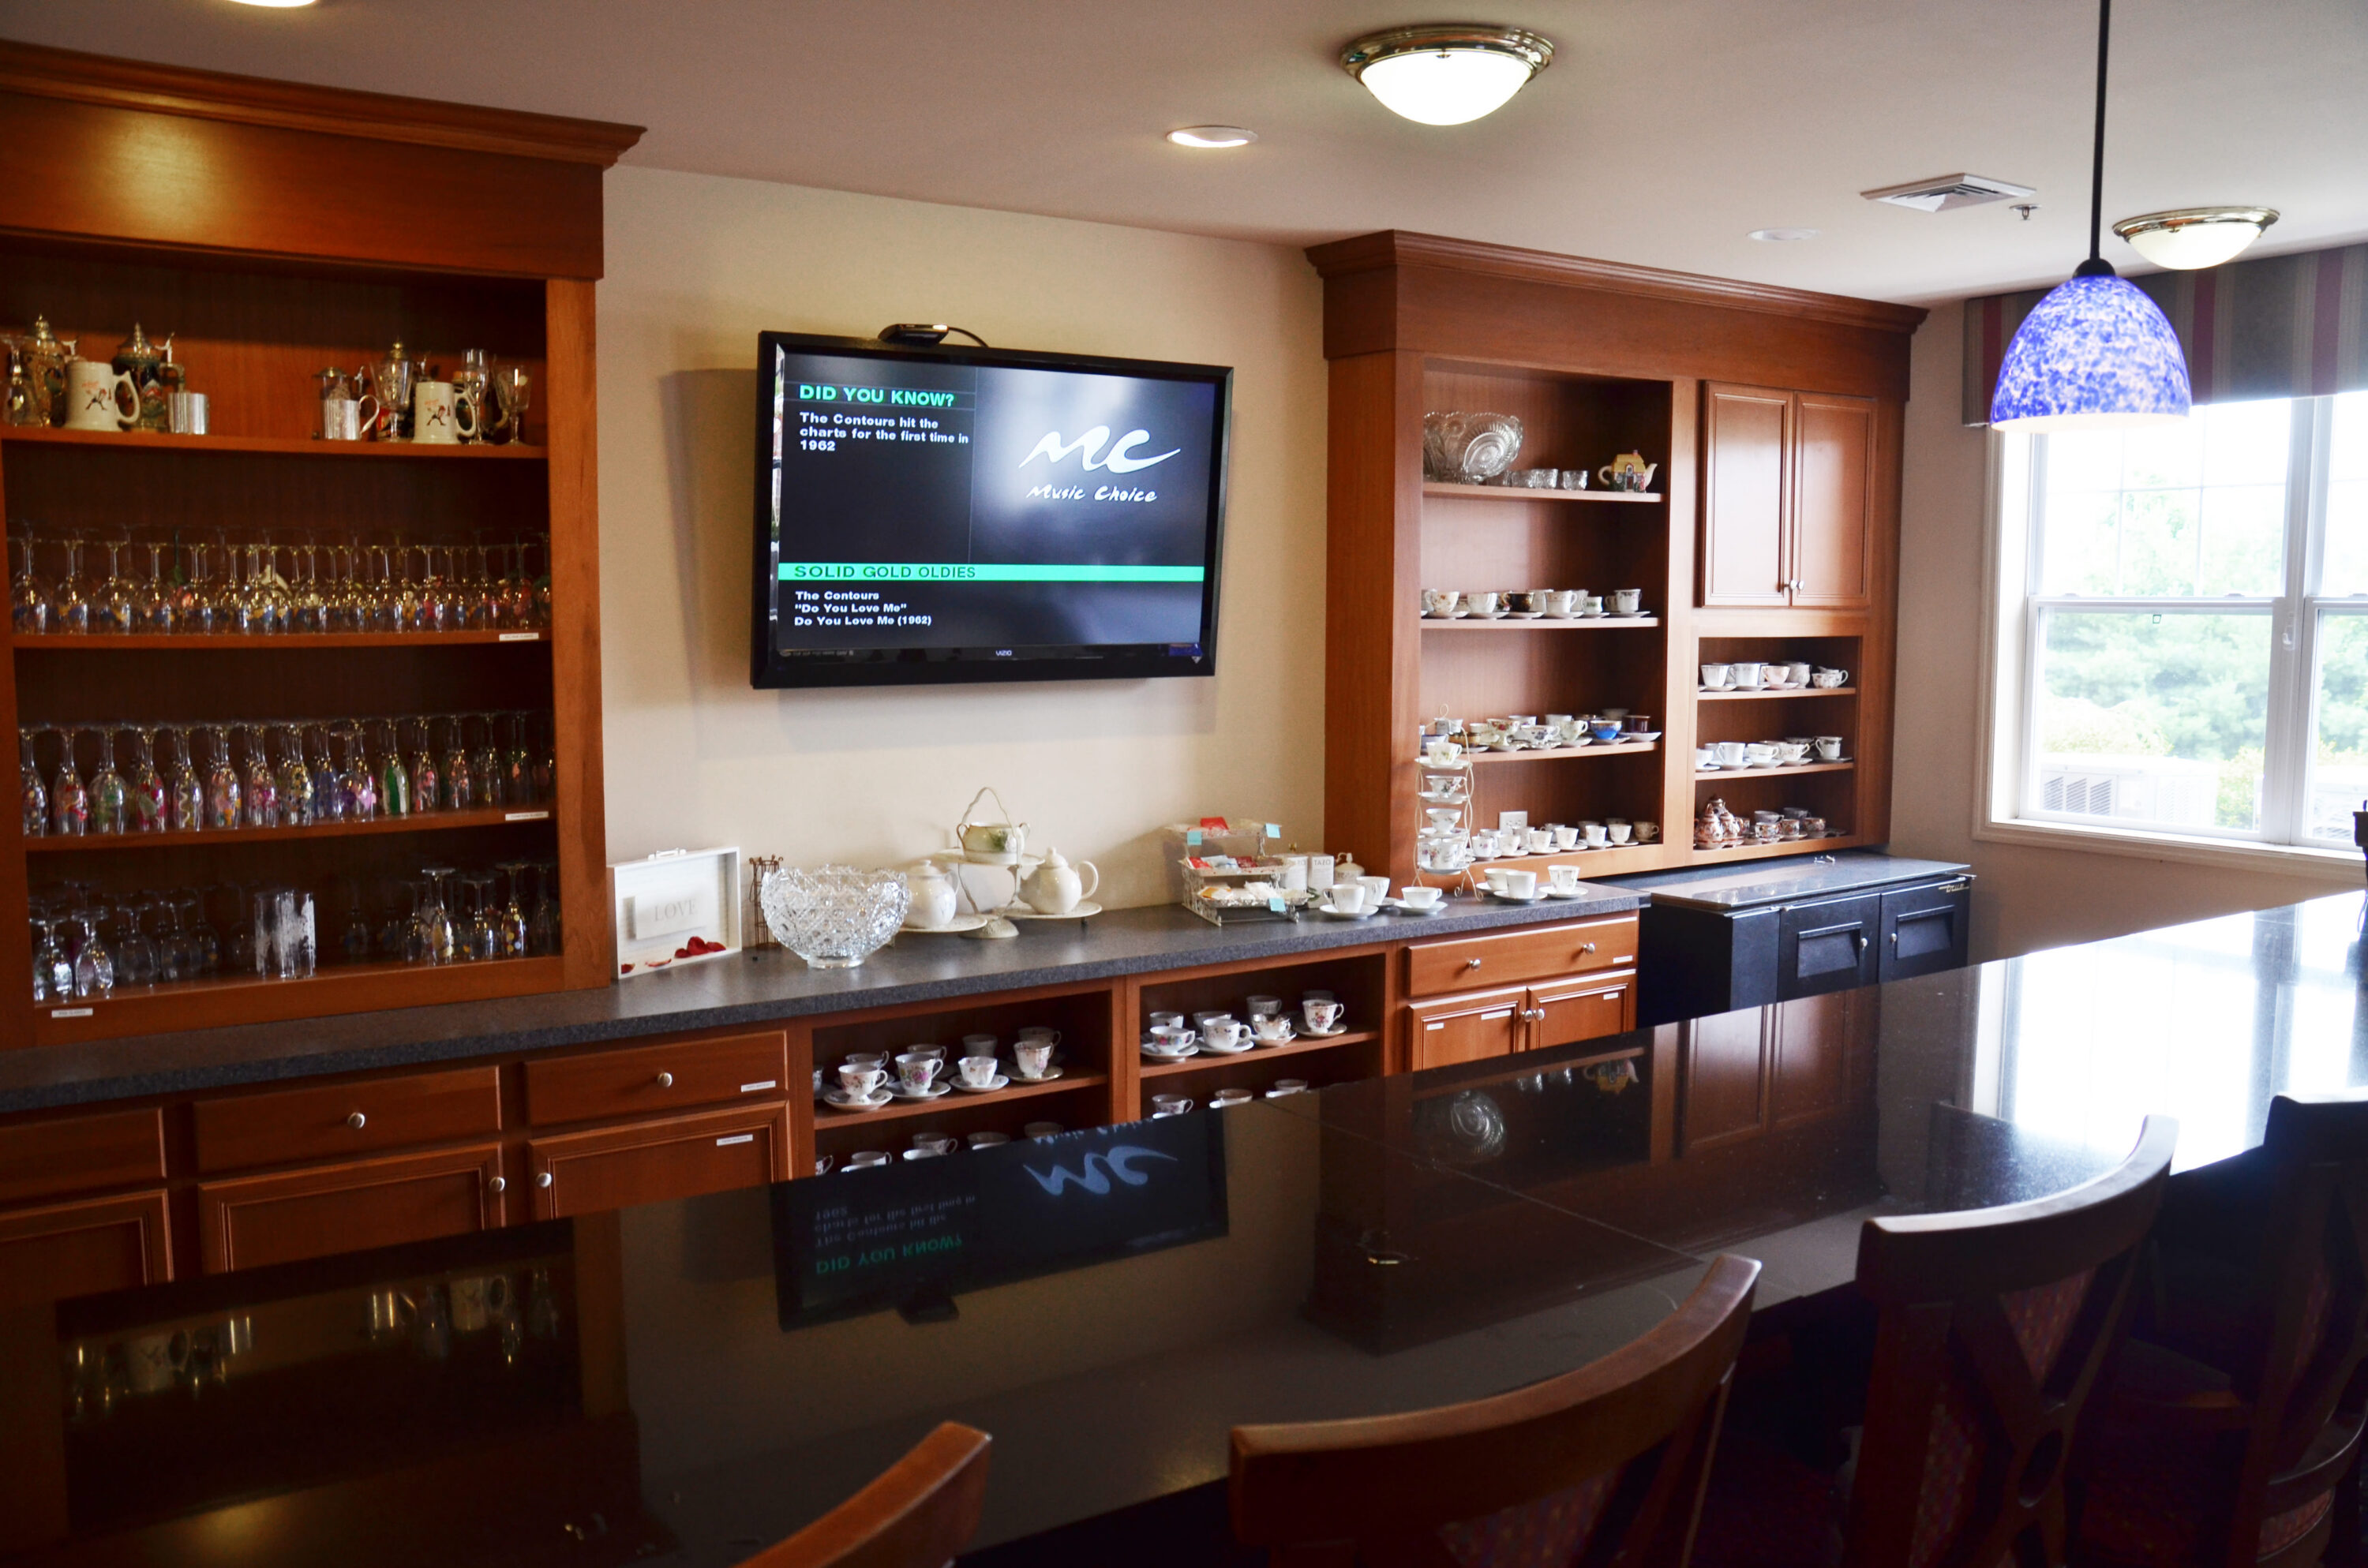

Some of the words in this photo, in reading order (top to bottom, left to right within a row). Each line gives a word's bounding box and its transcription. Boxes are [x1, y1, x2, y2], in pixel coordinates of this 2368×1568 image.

[799, 384, 837, 401] DID
[843, 387, 884, 403] YOU
[890, 391, 954, 407] KNOW?
[799, 411, 828, 424] The
[833, 413, 895, 427] Contours
[899, 417, 916, 428] hit
[920, 418, 939, 429] the
[799, 425, 846, 438] charts
[852, 428, 871, 440] for
[875, 429, 896, 440] the
[901, 430, 926, 442] first
[929, 432, 954, 443] time
[958, 432, 969, 443] in
[800, 440, 836, 451] 1962
[1026, 484, 1085, 500] Music
[1094, 485, 1157, 503] Choice
[794, 566, 855, 578] SOLID
[863, 566, 912, 578] GOLD
[918, 566, 976, 578] OLDIES
[795, 591, 819, 601] The
[823, 591, 879, 601] Contours
[795, 604, 819, 613] "Do
[823, 604, 848, 613] You
[851, 603, 880, 613] Love
[883, 603, 907, 612] Me"
[794, 616, 812, 626] Do
[816, 616, 841, 626] You
[845, 616, 874, 626] Love
[877, 616, 894, 625] Me
[897, 616, 932, 627] (1962)
[654, 898, 698, 922] LOVE
